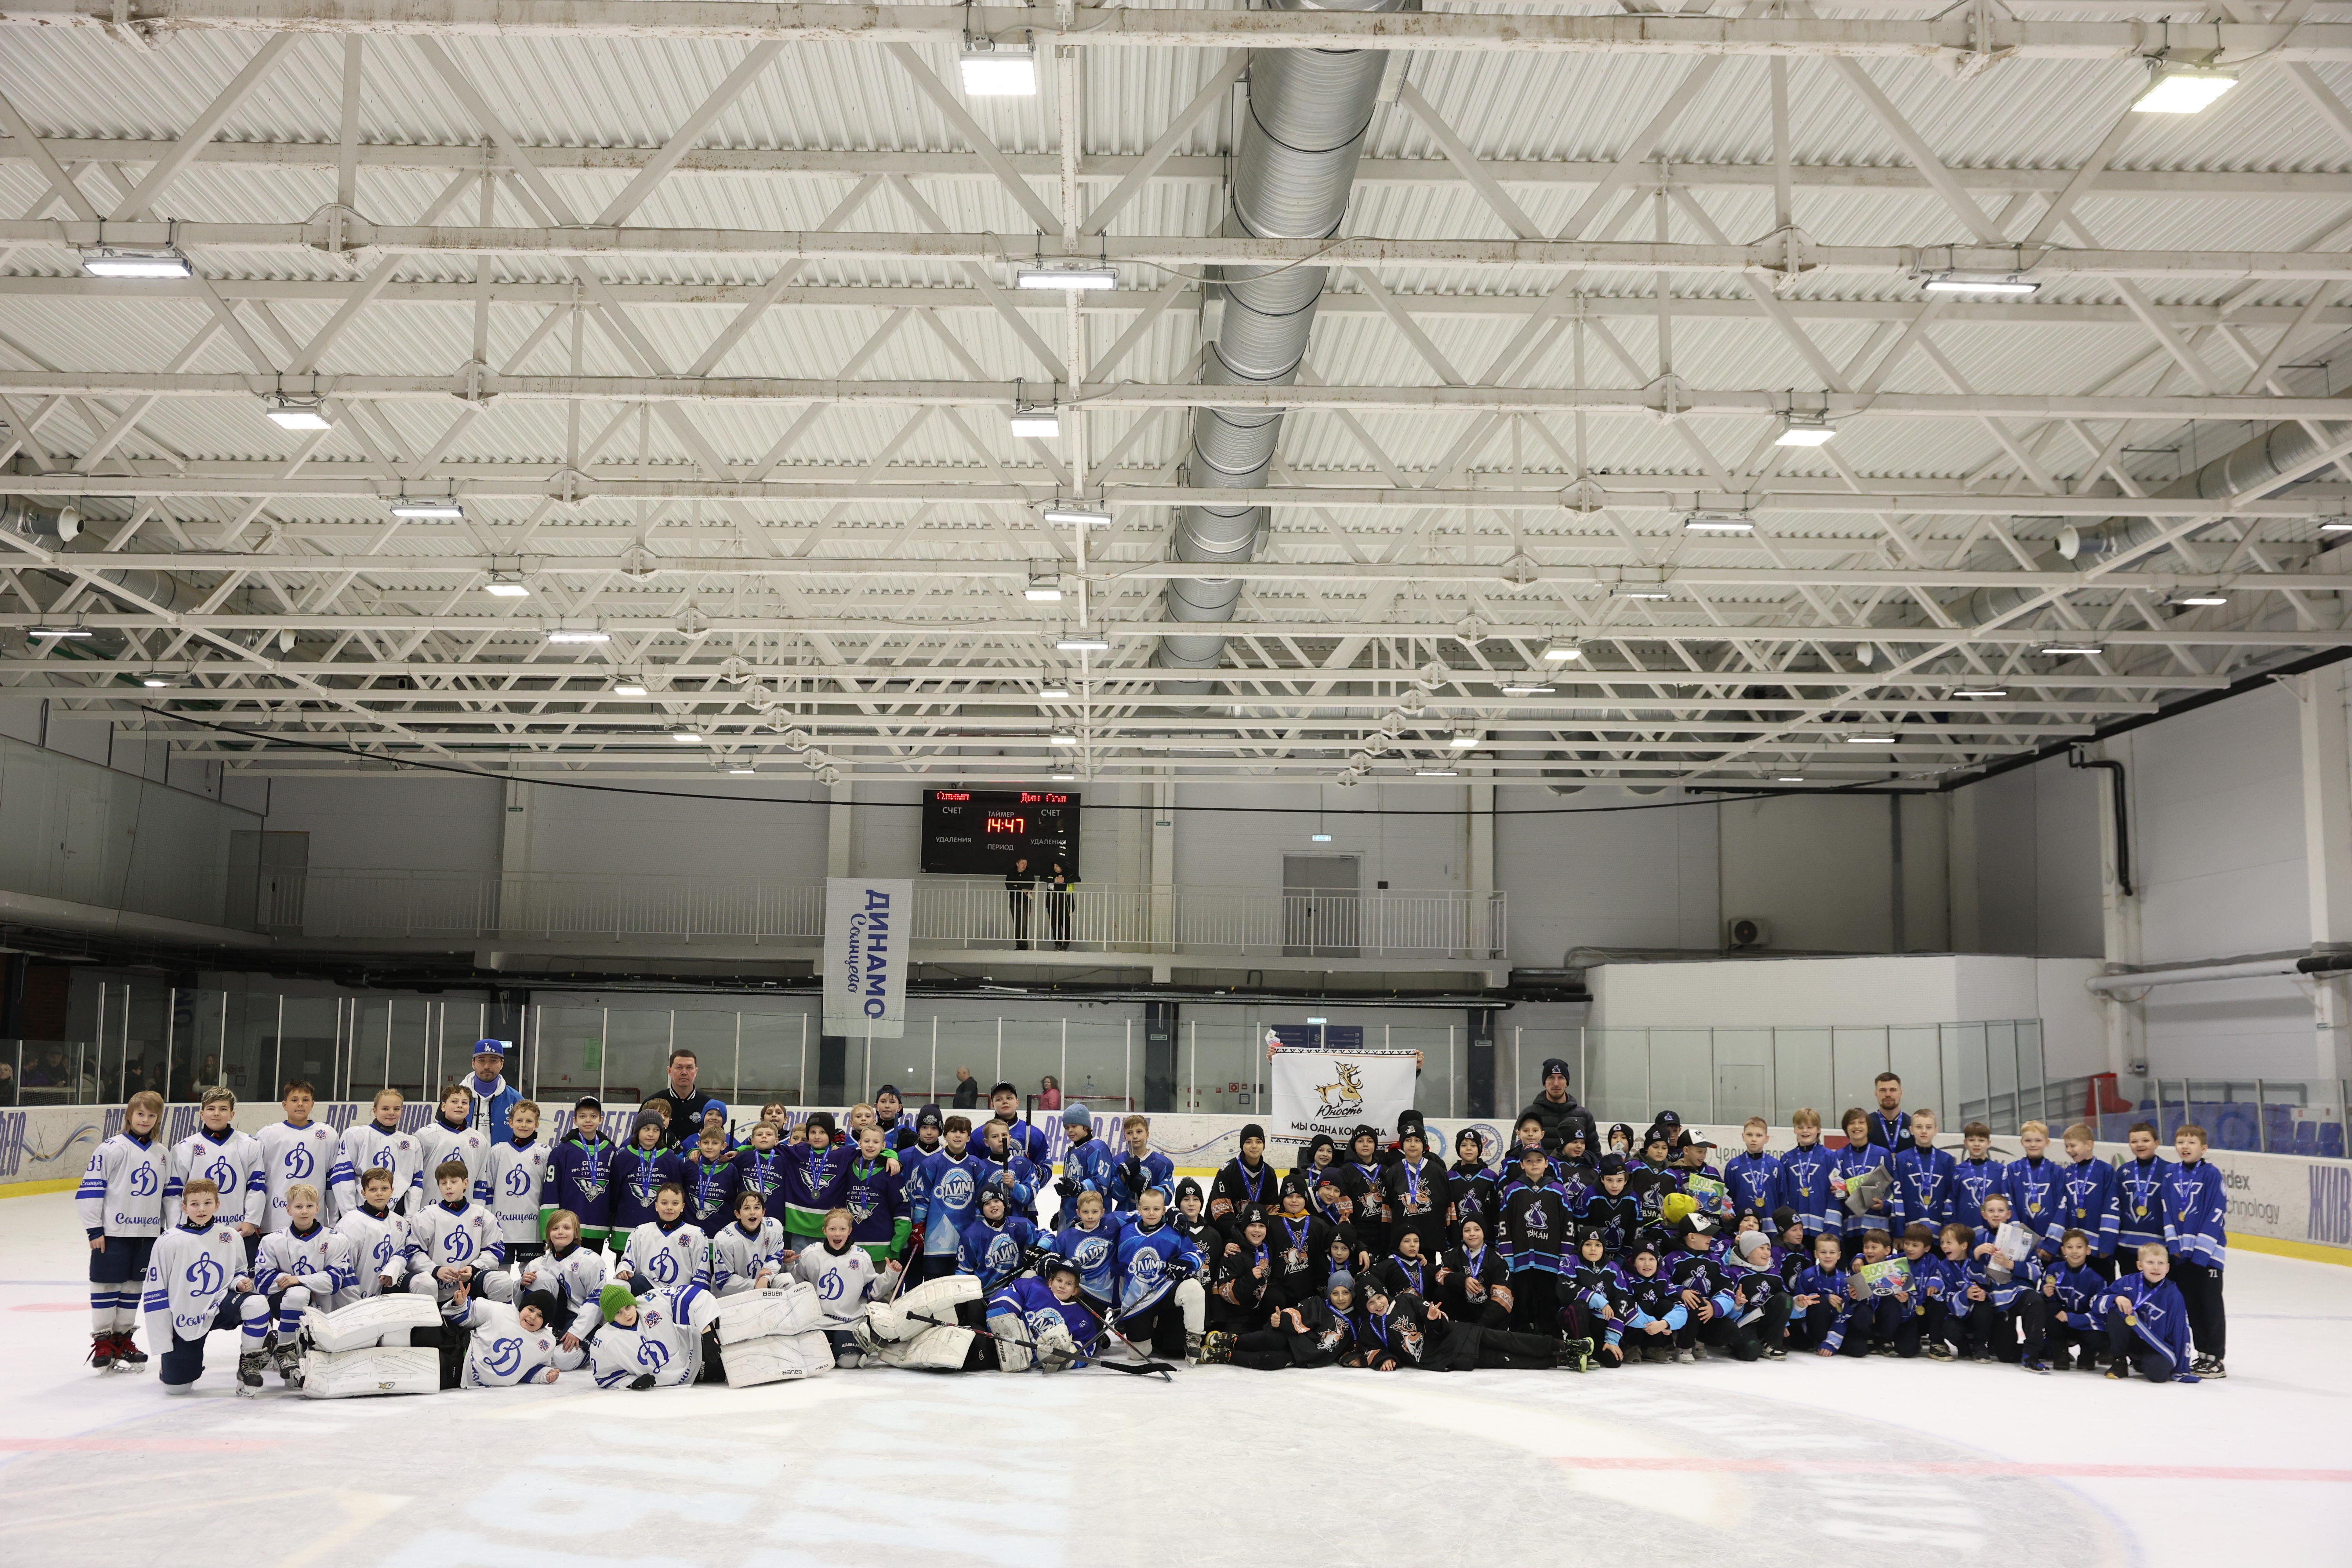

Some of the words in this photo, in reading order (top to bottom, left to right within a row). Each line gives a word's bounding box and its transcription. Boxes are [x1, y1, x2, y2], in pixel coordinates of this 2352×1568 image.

[987, 818, 1024, 833] 14:47
[845, 913, 867, 993] Солнцево
[864, 889, 889, 1019] ДИНАМО
[484, 1043, 491, 1052] LA
[1314, 1104, 1363, 1120] Юность
[1291, 1121, 1307, 1131] МЫ
[1310, 1123, 1337, 1135] ОДНА
[1339, 1127, 1387, 1136] КОМДА
[1098, 1160, 1111, 1179] 87
[495, 1210, 538, 1223] Солнцево
[2225, 1195, 2279, 1224] chnology
[1127, 1260, 1167, 1274] ОЛИМП
